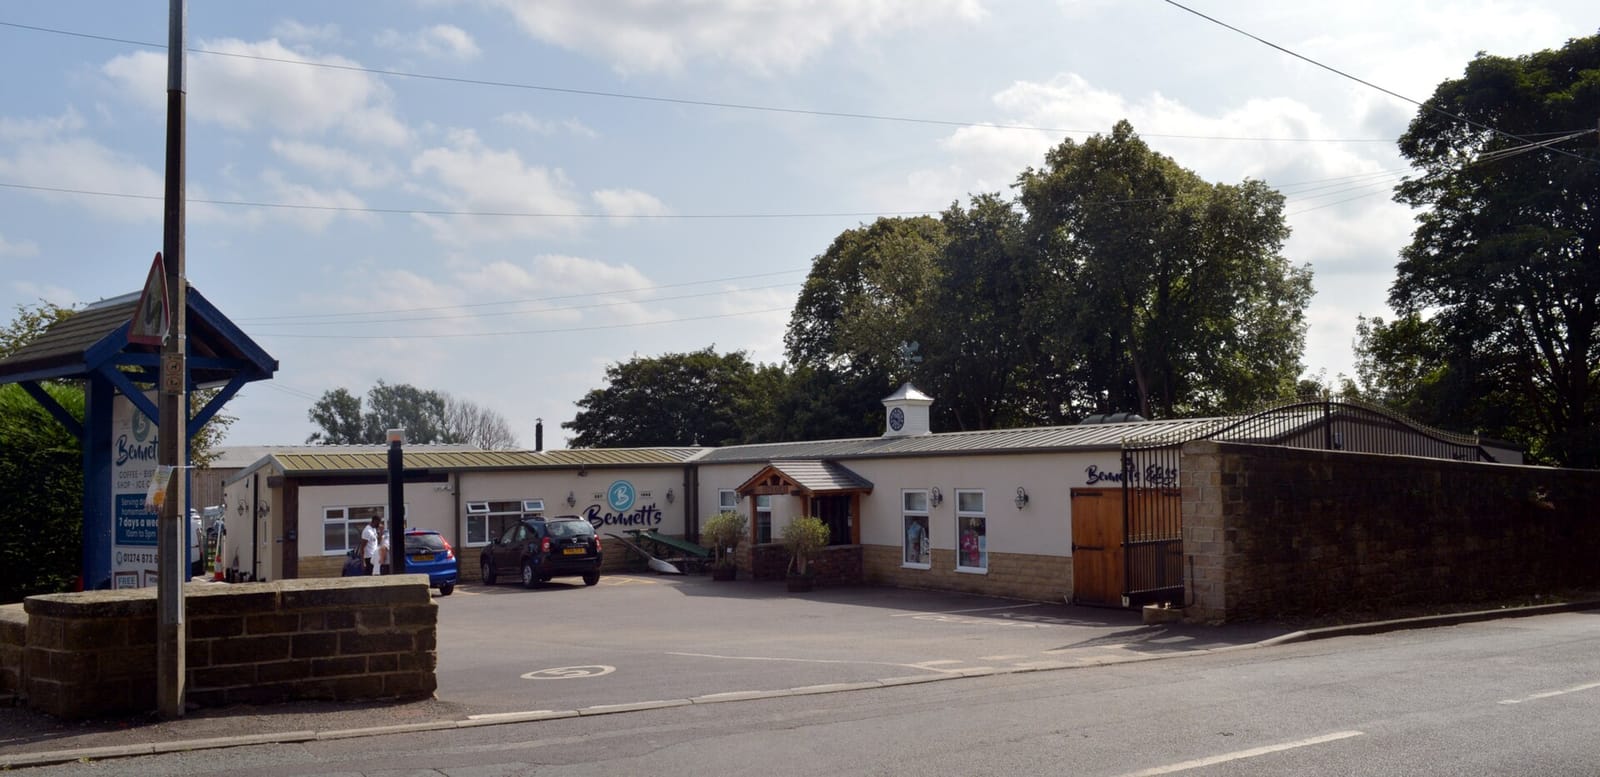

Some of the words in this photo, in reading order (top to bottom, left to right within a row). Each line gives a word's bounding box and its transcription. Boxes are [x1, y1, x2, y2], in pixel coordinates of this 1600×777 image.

[583, 503, 662, 530] Bennett's
[123, 517, 139, 530] days
[140, 519, 145, 527] a
[123, 552, 140, 563] 01274
[118, 576, 136, 585] FREE
